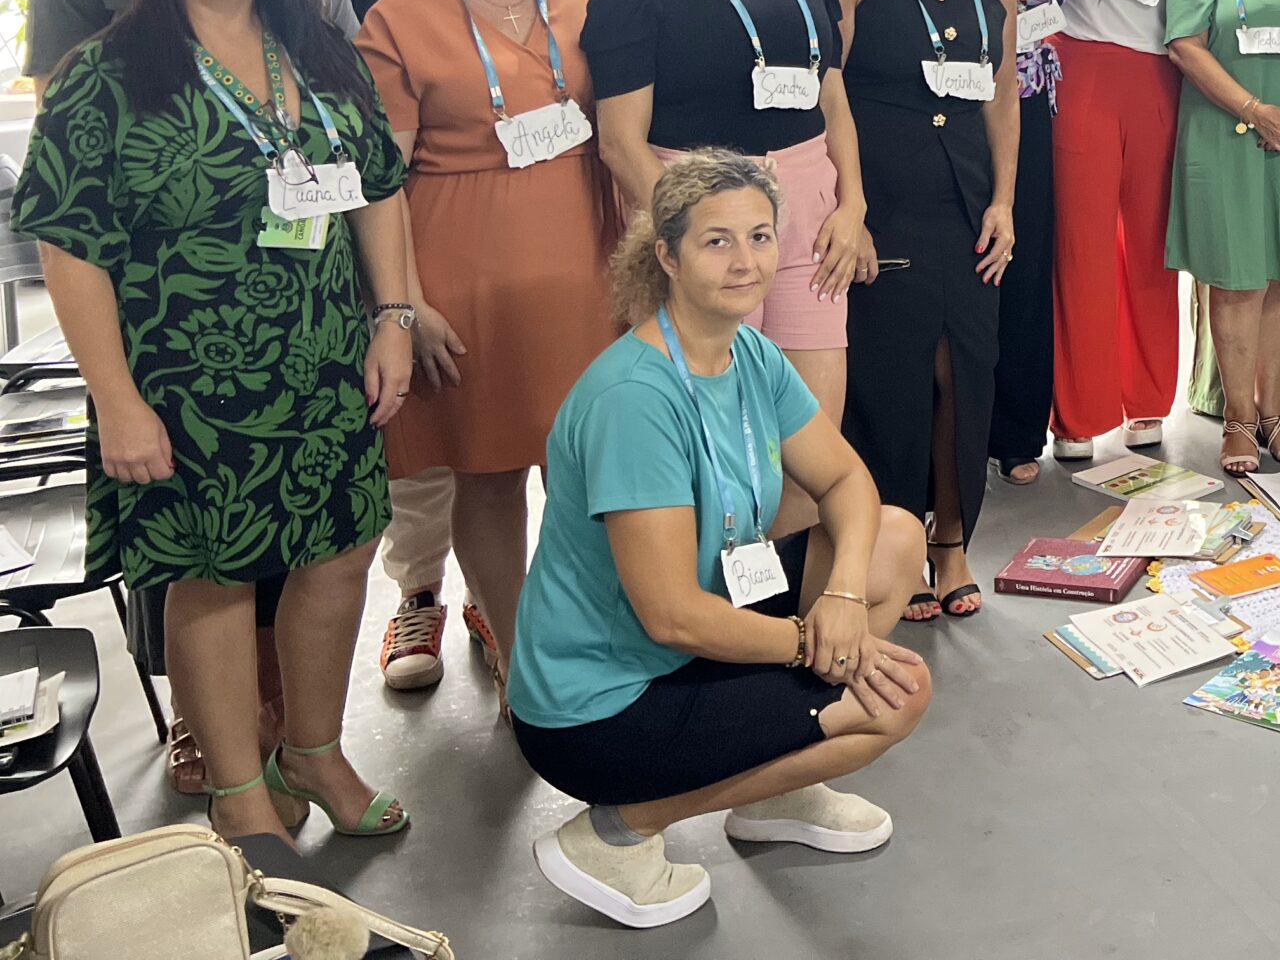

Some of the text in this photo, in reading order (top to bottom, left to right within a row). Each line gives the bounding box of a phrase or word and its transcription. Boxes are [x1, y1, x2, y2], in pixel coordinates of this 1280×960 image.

[761, 72, 811, 104] Sandra
[511, 110, 580, 158] Angela
[282, 175, 359, 211] Luana G.
[1015, 583, 1030, 591] Uma
[1030, 584, 1053, 593] História
[1062, 588, 1095, 598] Construção
